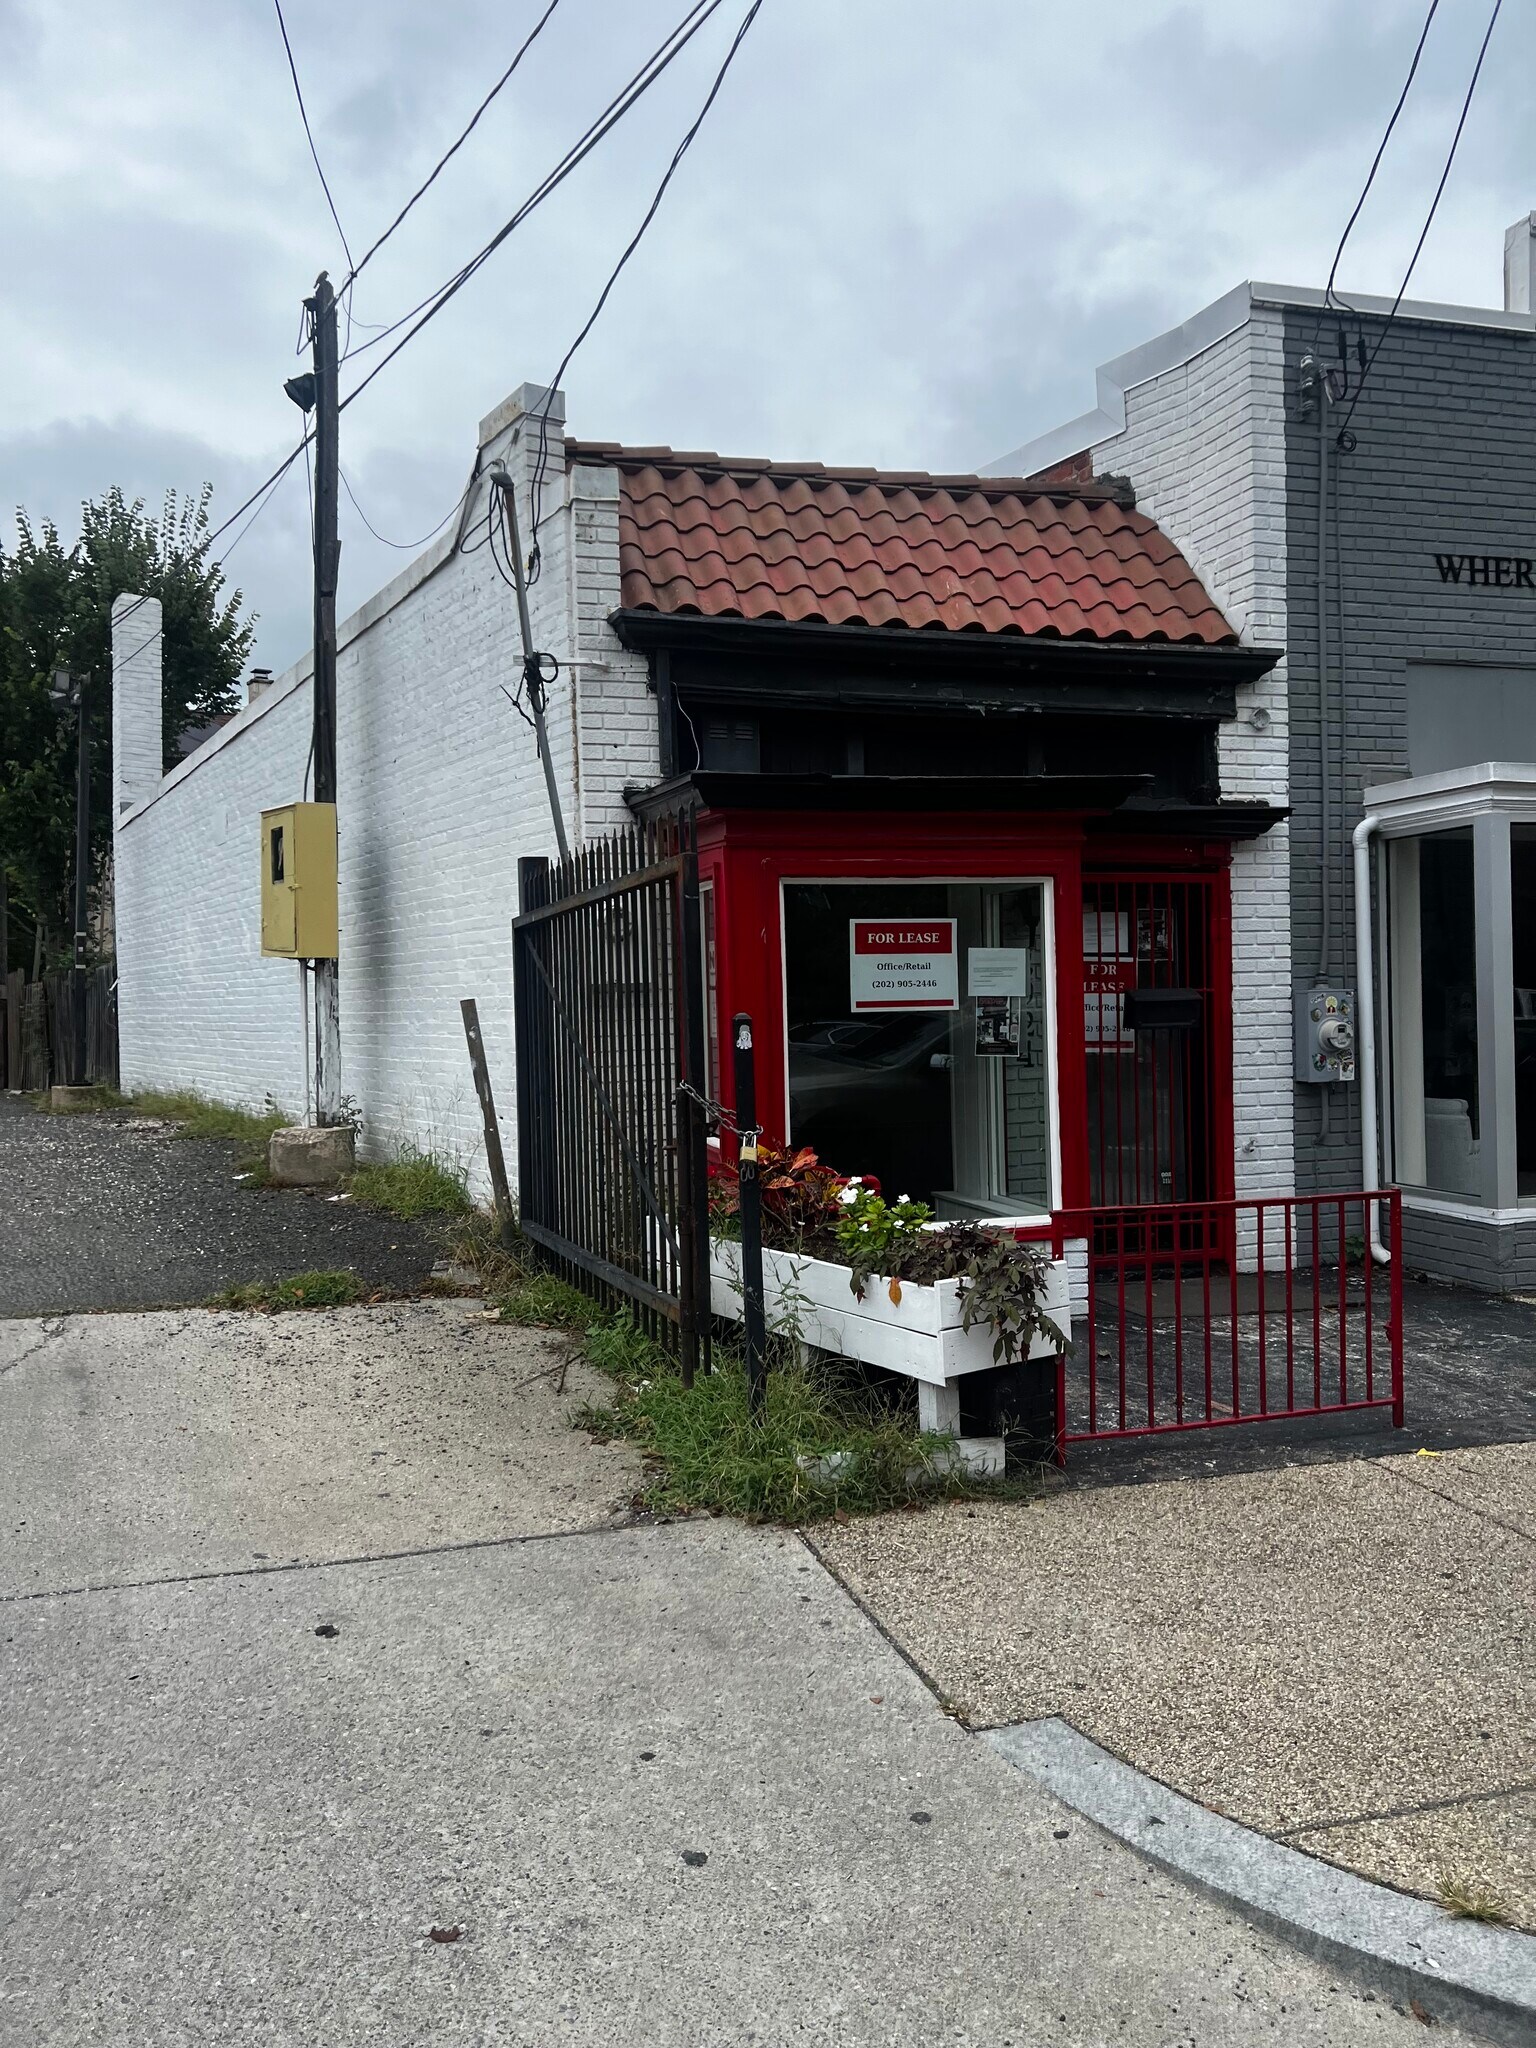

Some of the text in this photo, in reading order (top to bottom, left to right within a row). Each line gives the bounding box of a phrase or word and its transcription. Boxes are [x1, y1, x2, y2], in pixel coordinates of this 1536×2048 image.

[1434, 553, 1536, 588] WHER
[867, 932, 940, 944] FOR LEASE
[876, 962, 931, 971] Office/Retail
[872, 979, 937, 989] (202) 905-2446
